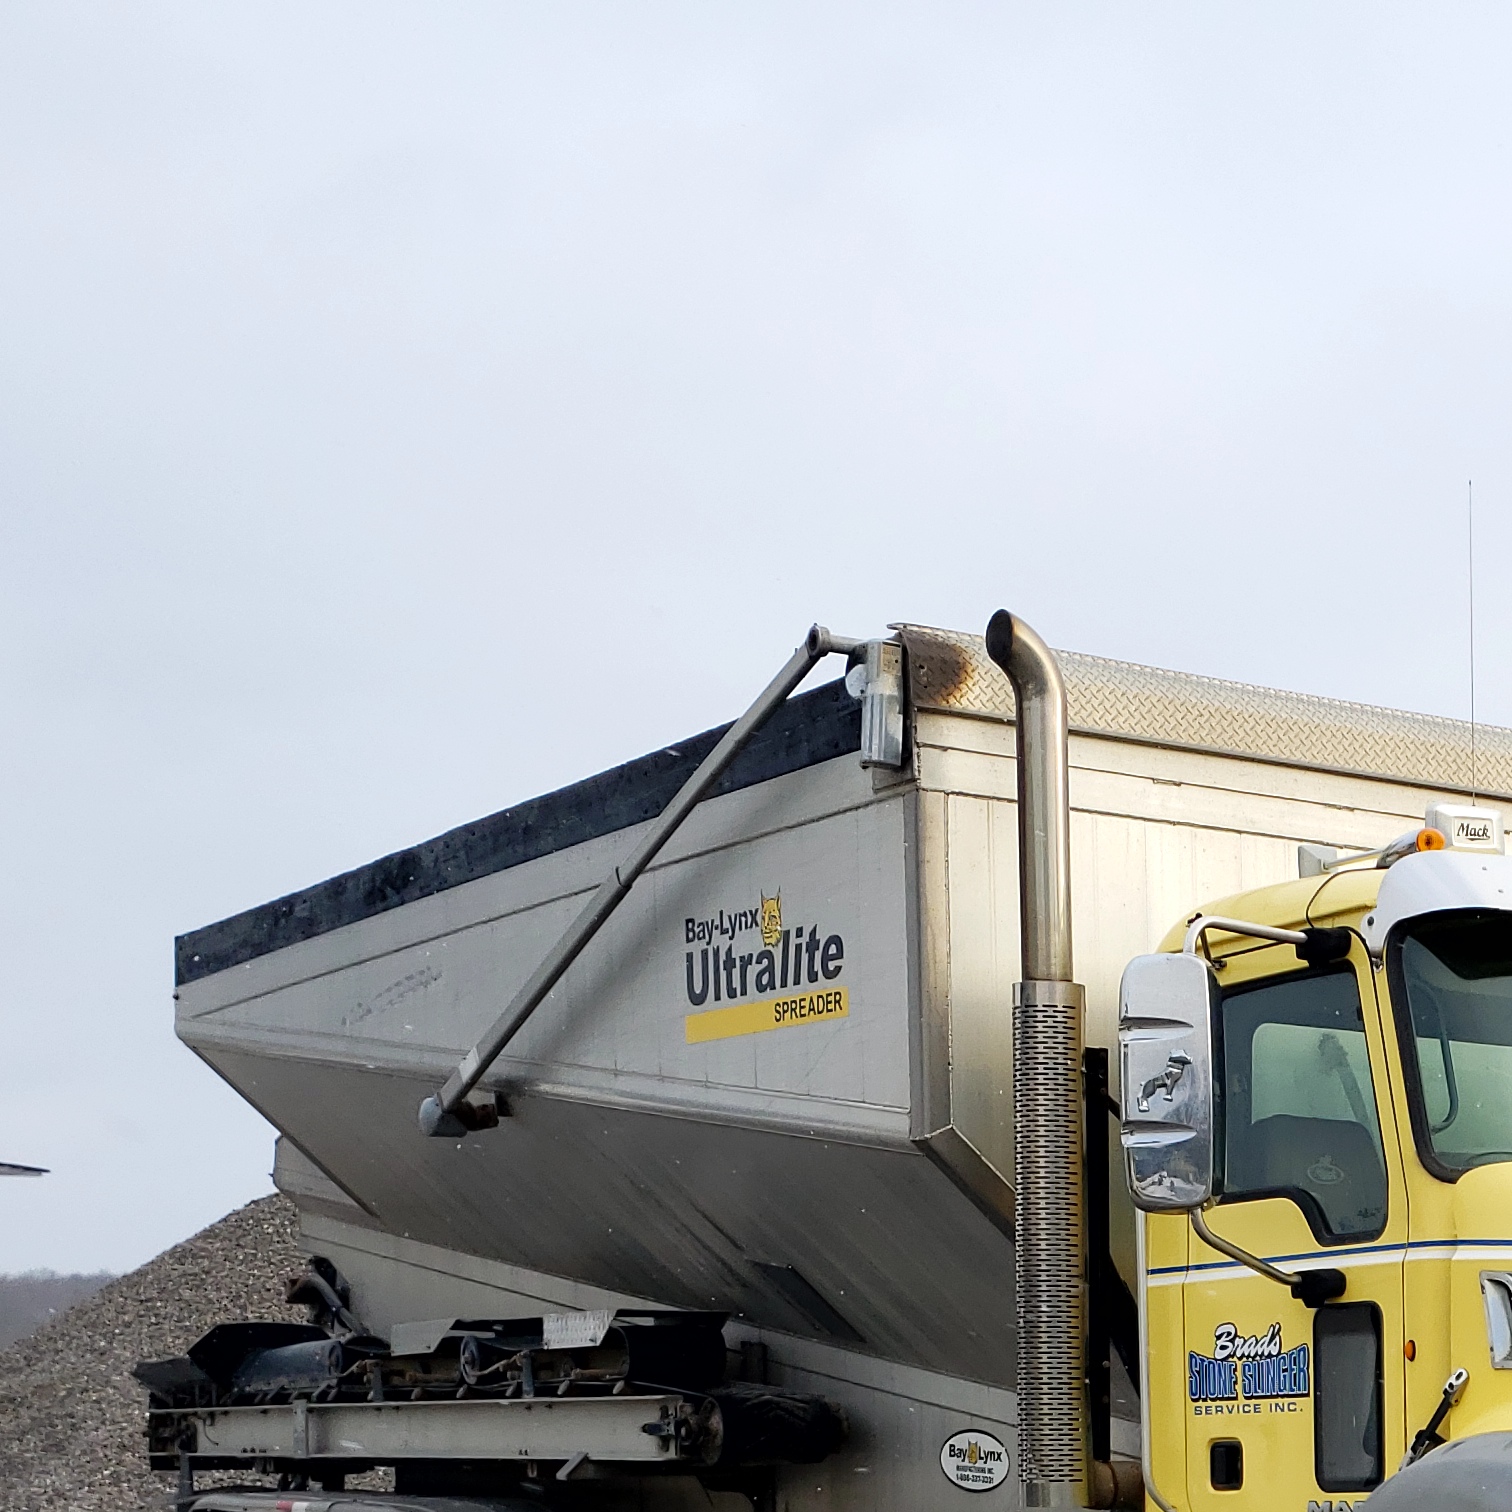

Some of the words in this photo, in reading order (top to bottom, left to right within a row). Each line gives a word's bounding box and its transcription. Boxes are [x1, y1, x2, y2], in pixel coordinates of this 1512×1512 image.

[1457, 822, 1490, 839] Mack
[685, 907, 760, 945] Bay-Lynx
[686, 924, 845, 1006] Ultralite
[774, 991, 843, 1023] SPREADER
[1214, 1322, 1282, 1361] Brad's
[1188, 1350, 1238, 1401] STONE
[1241, 1343, 1311, 1400] SLINGER
[1194, 1402, 1262, 1416] SERVICE
[1269, 1401, 1304, 1413] INC.
[948, 1443, 967, 1463] Bay
[978, 1446, 1003, 1465] Lynx
